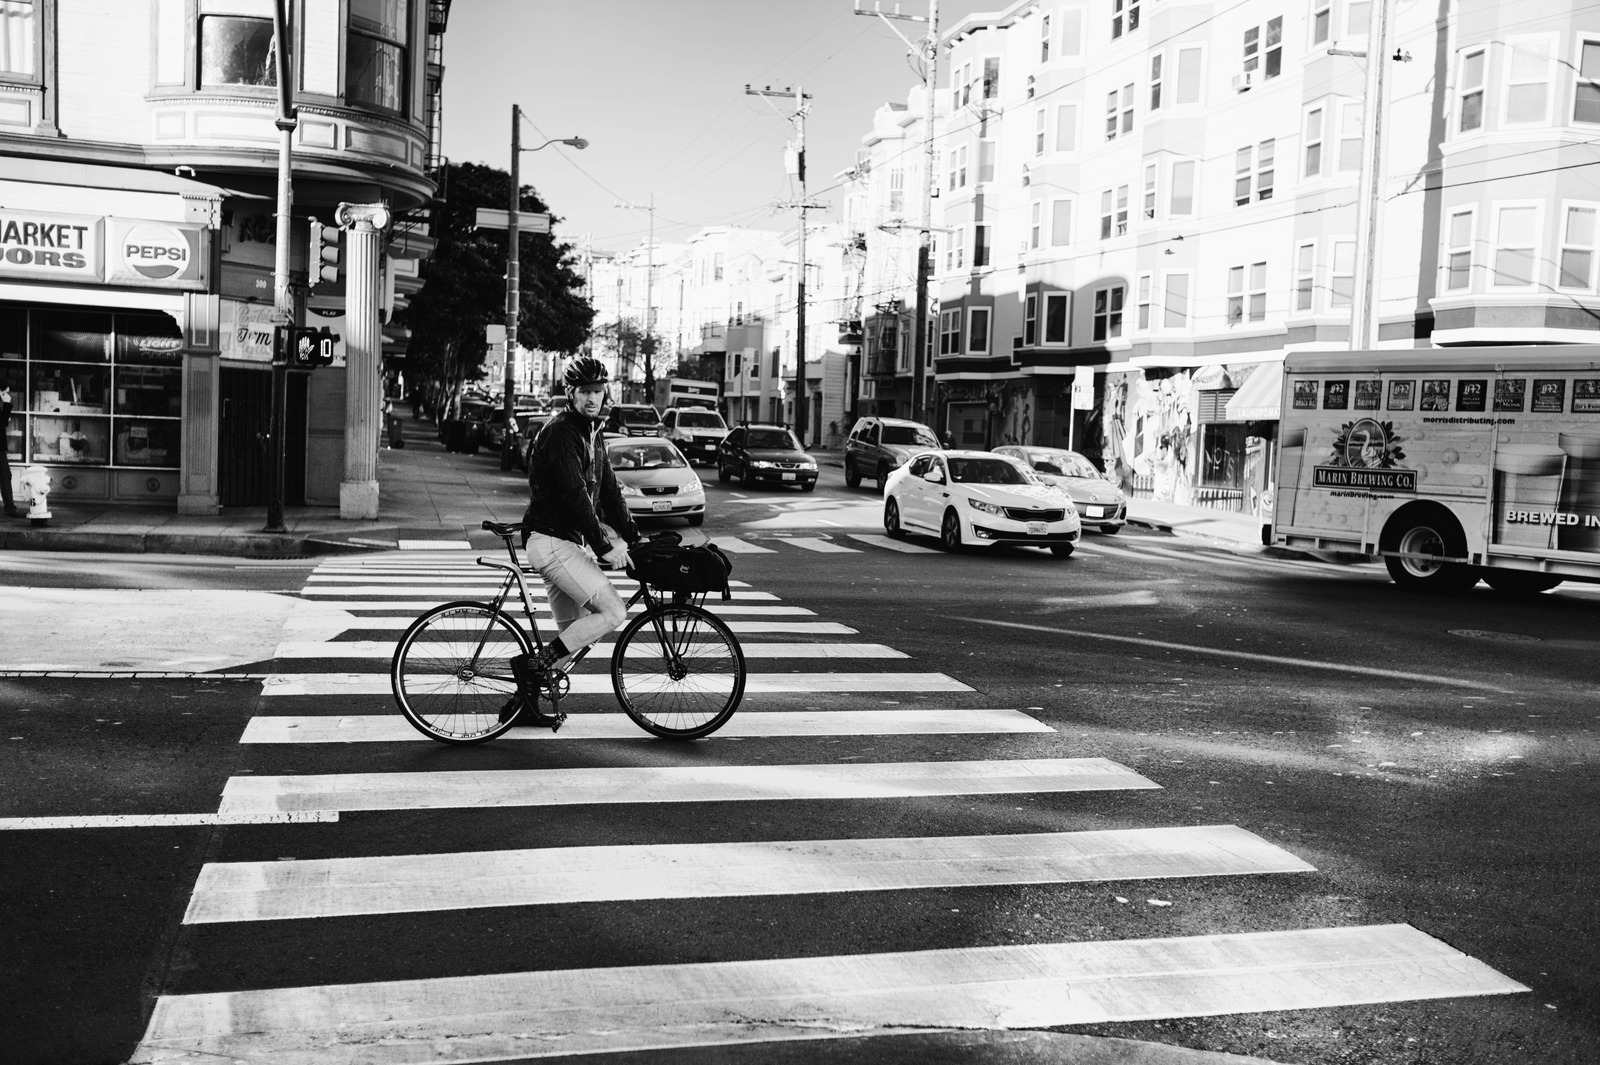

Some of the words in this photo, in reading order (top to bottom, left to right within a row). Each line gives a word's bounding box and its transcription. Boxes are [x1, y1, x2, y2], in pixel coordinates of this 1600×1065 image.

[0, 220, 88, 250] ARKET
[0, 247, 86, 268] ORS
[126, 244, 186, 261] PEPSI
[1423, 416, 1515, 426] morrisdistributing.com
[1317, 470, 1347, 484] MARIN
[1350, 472, 1393, 487] BREWING
[1329, 490, 1395, 500] marinbrewing.com
[1506, 510, 1579, 526] BREWED
